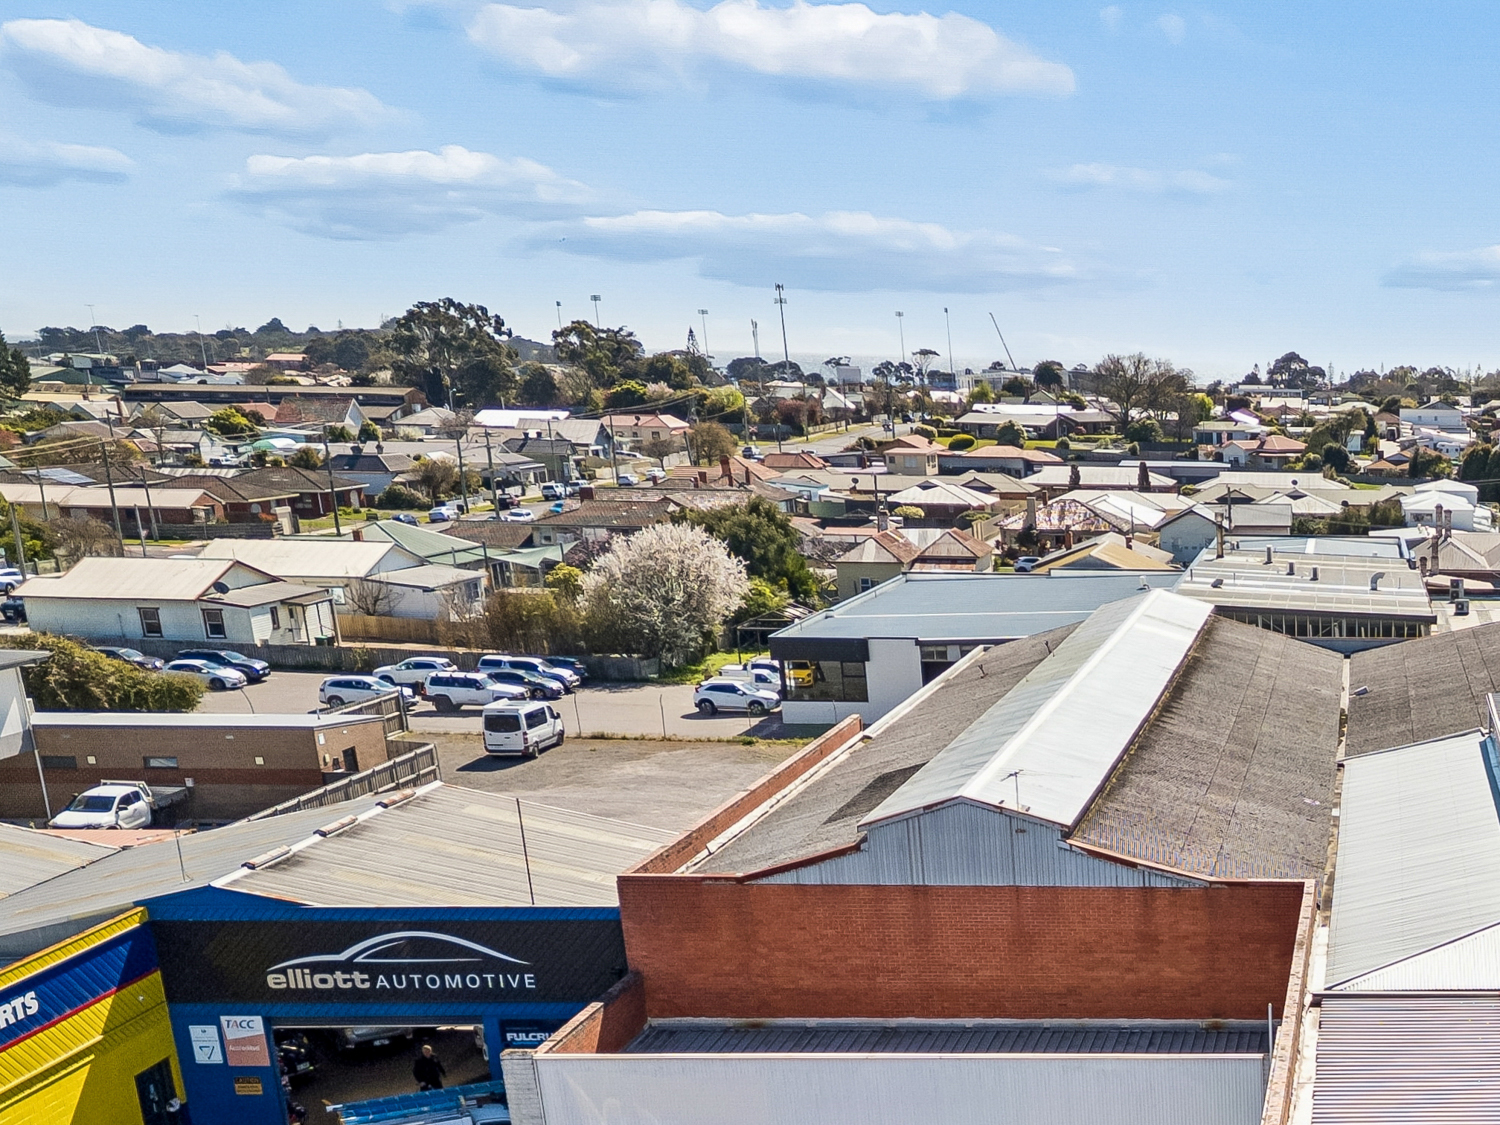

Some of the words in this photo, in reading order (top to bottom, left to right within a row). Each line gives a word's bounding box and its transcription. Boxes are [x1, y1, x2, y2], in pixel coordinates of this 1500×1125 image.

[266, 968, 371, 990] elliott
[375, 973, 537, 989] AUTOMOTIVE
[224, 1019, 256, 1029] TACC
